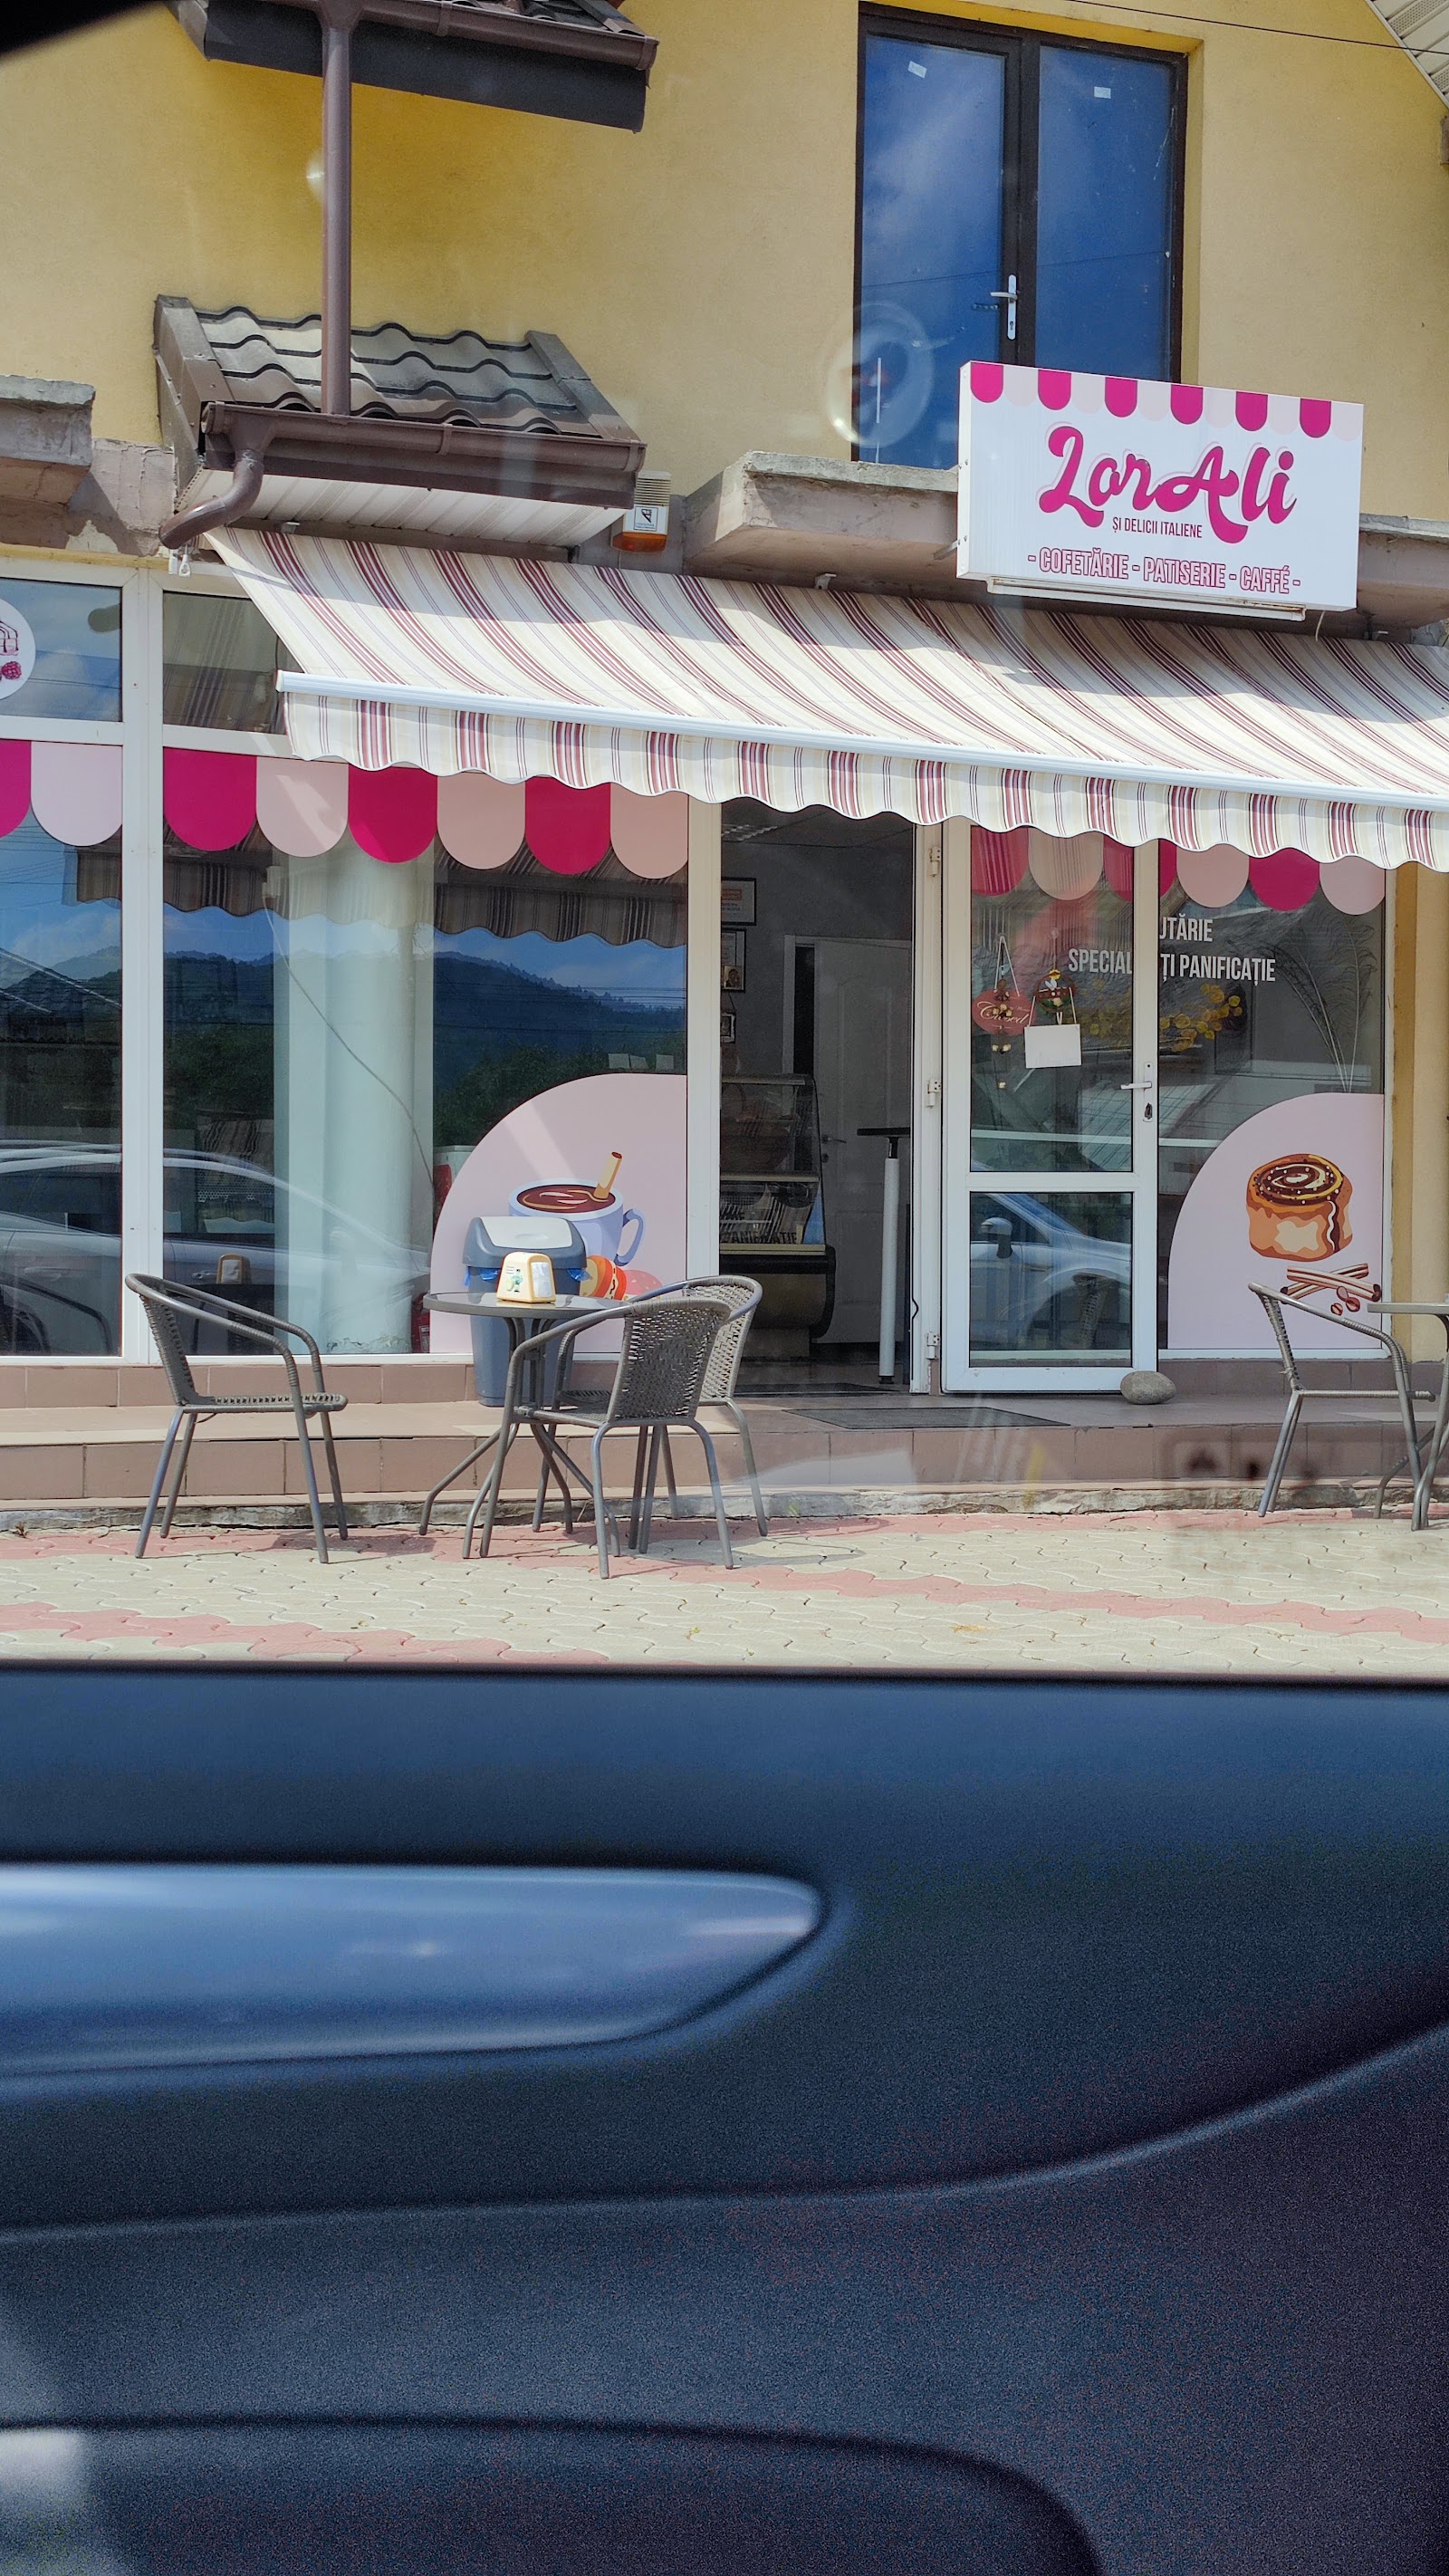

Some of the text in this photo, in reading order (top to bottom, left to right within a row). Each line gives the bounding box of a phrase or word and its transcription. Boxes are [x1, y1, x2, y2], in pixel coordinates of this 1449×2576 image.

[1112, 516, 1203, 539] ȘI DELICII ITALIENE
[1039, 547, 1129, 580] COFETĂRIE
[1143, 556, 1226, 589] PATISERIE
[1239, 565, 1291, 594] CAFFÉ
[1179, 954, 1276, 986] PANIFICAȚIE
